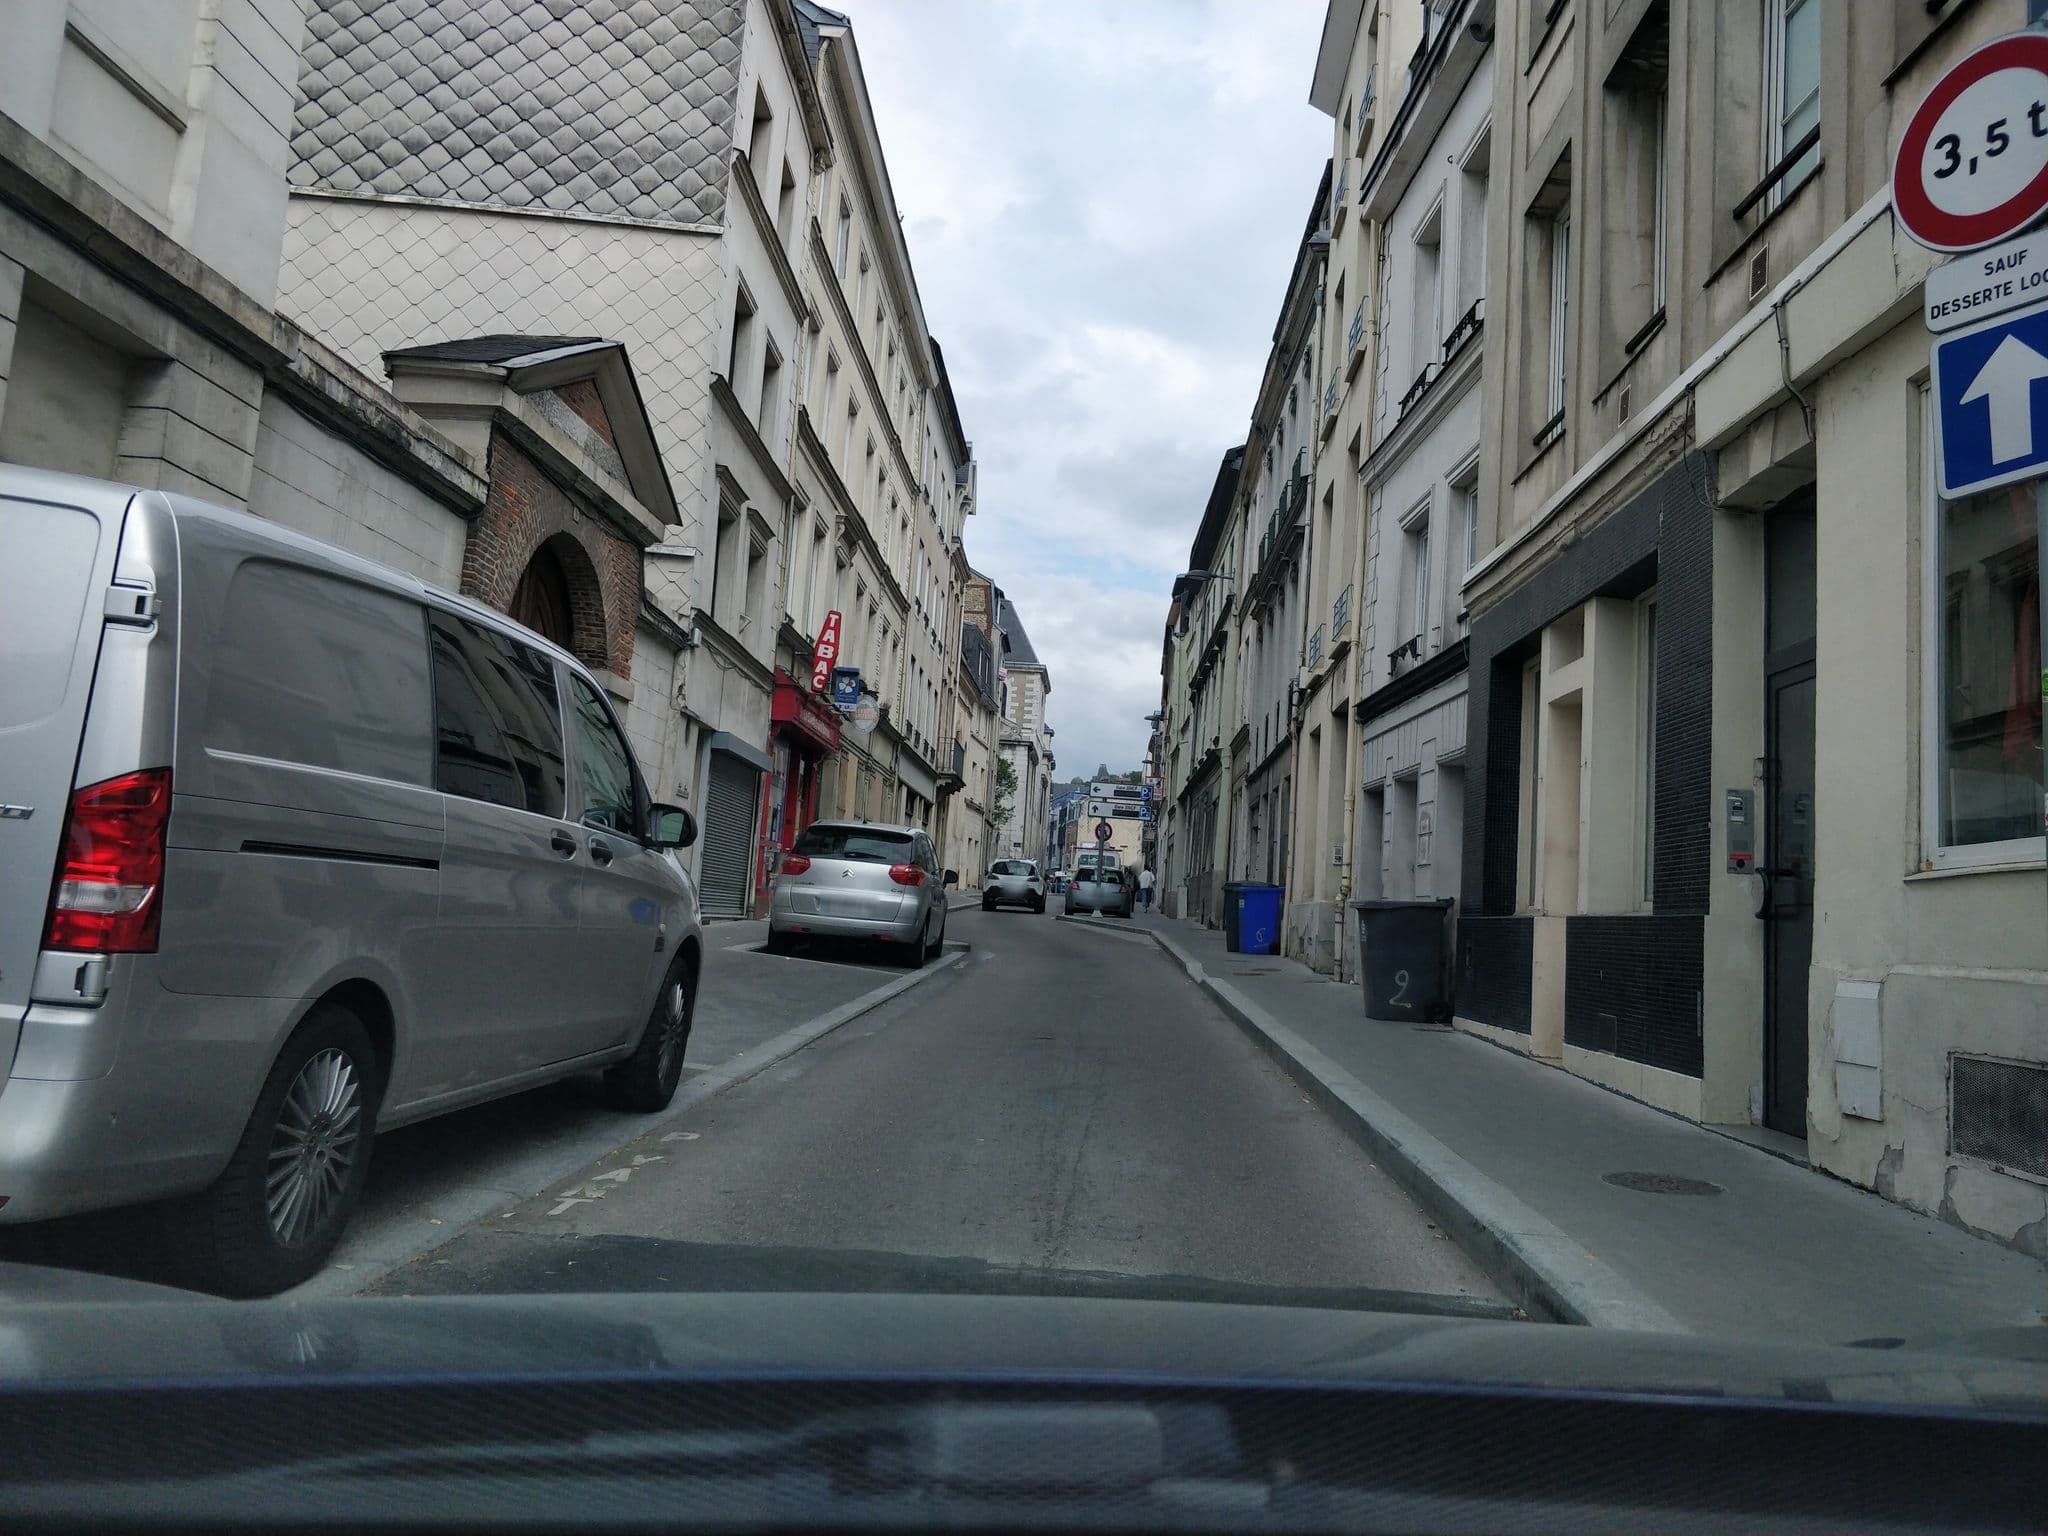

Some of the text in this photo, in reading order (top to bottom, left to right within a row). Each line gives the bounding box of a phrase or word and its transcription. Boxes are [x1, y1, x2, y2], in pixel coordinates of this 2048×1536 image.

[1933, 116, 2010, 179] 3,5
[1984, 249, 2028, 276] SAUF
[1930, 281, 2013, 320] DESSERTE
[813, 613, 840, 689] TABAC
[1388, 969, 1413, 1009] 2
